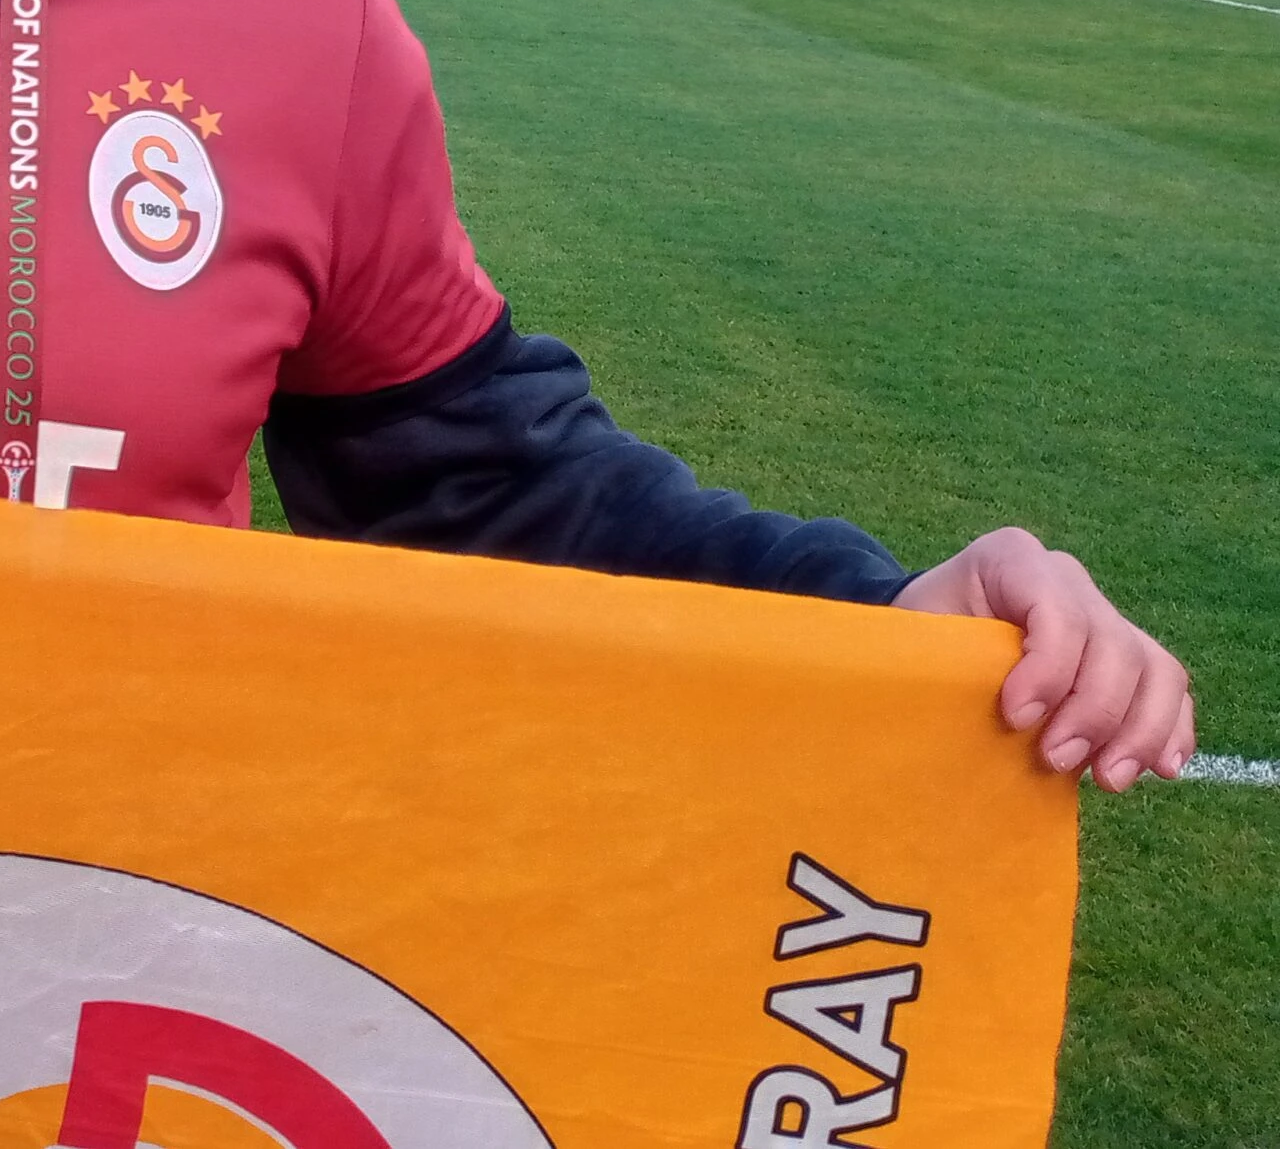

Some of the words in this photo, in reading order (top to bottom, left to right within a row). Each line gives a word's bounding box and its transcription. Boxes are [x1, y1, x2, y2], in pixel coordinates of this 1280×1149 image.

[10, 42, 40, 190] NATIONS
[138, 202, 171, 219] 1905
[6, 195, 37, 381] MOROCCO
[4, 387, 33, 427] 25
[734, 850, 932, 1149] RAY
